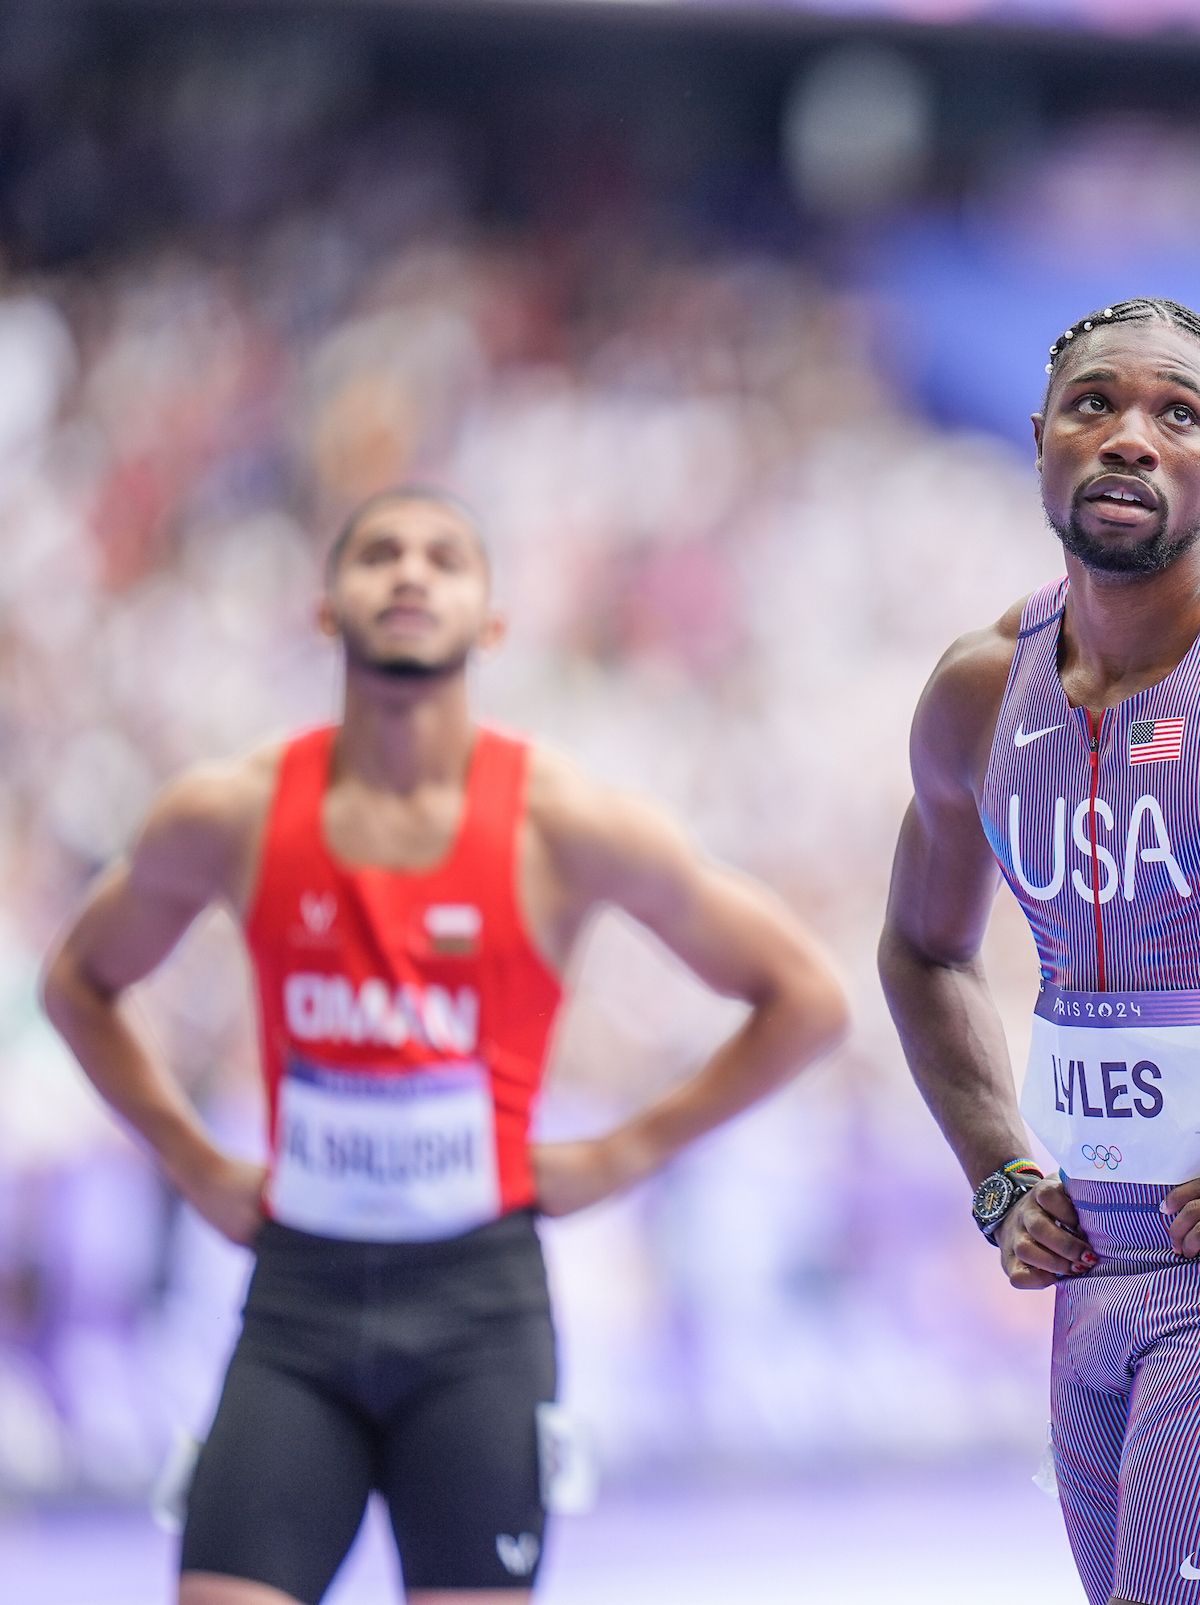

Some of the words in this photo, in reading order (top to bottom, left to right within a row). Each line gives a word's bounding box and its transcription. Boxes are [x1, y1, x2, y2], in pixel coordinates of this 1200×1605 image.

[1009, 793, 1192, 905] USA
[283, 971, 481, 1055] OMAN
[1085, 1001, 1142, 1018] 2024
[1052, 1054, 1164, 1119] LYLES
